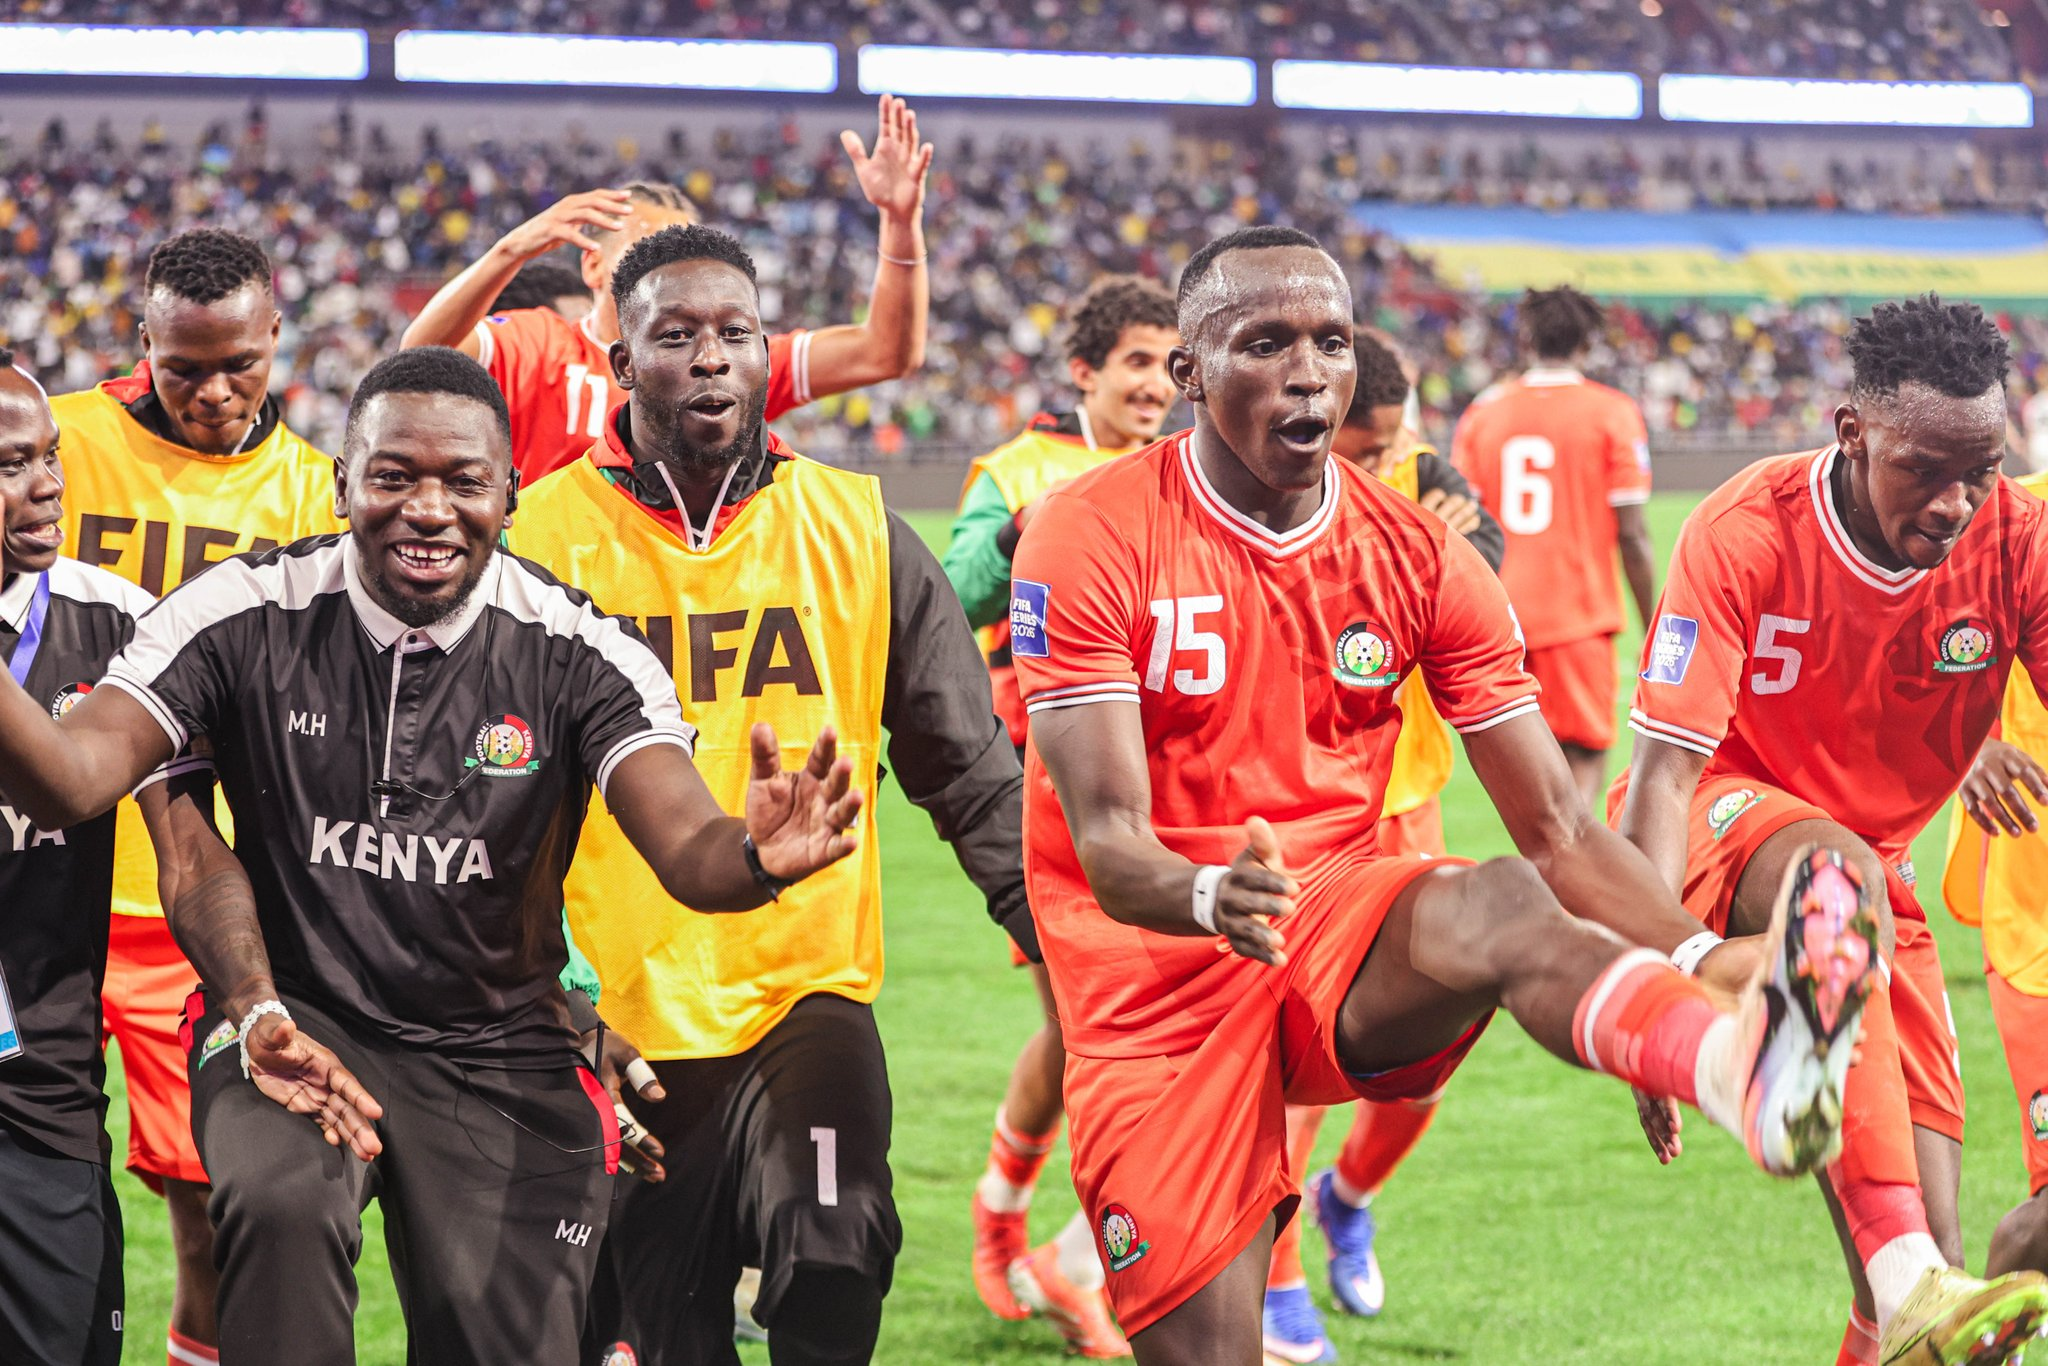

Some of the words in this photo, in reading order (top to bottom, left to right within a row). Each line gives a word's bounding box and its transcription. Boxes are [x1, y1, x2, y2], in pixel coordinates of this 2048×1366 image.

[565, 363, 609, 438] 11
[1500, 434, 1555, 536] 6
[1013, 597, 1031, 613] FIFA
[630, 606, 824, 702] IFA
[1144, 594, 1226, 696] 15
[1336, 629, 1353, 670] FOOTBALL
[1383, 640, 1393, 667] KENYA
[1751, 613, 1811, 696] 5
[1941, 627, 1956, 661] FOOTBALL
[1985, 631, 1993, 654] KENYA
[1341, 676, 1386, 686] FEDERATION
[1944, 661, 1987, 672] FEDERATION
[288, 709, 327, 737] M.H
[522, 729, 534, 759] KENYA
[310, 815, 494, 885] KENYA
[810, 1126, 838, 1206] 1
[554, 1219, 593, 1248] M.H
[1123, 1212, 1137, 1240] KENYA
